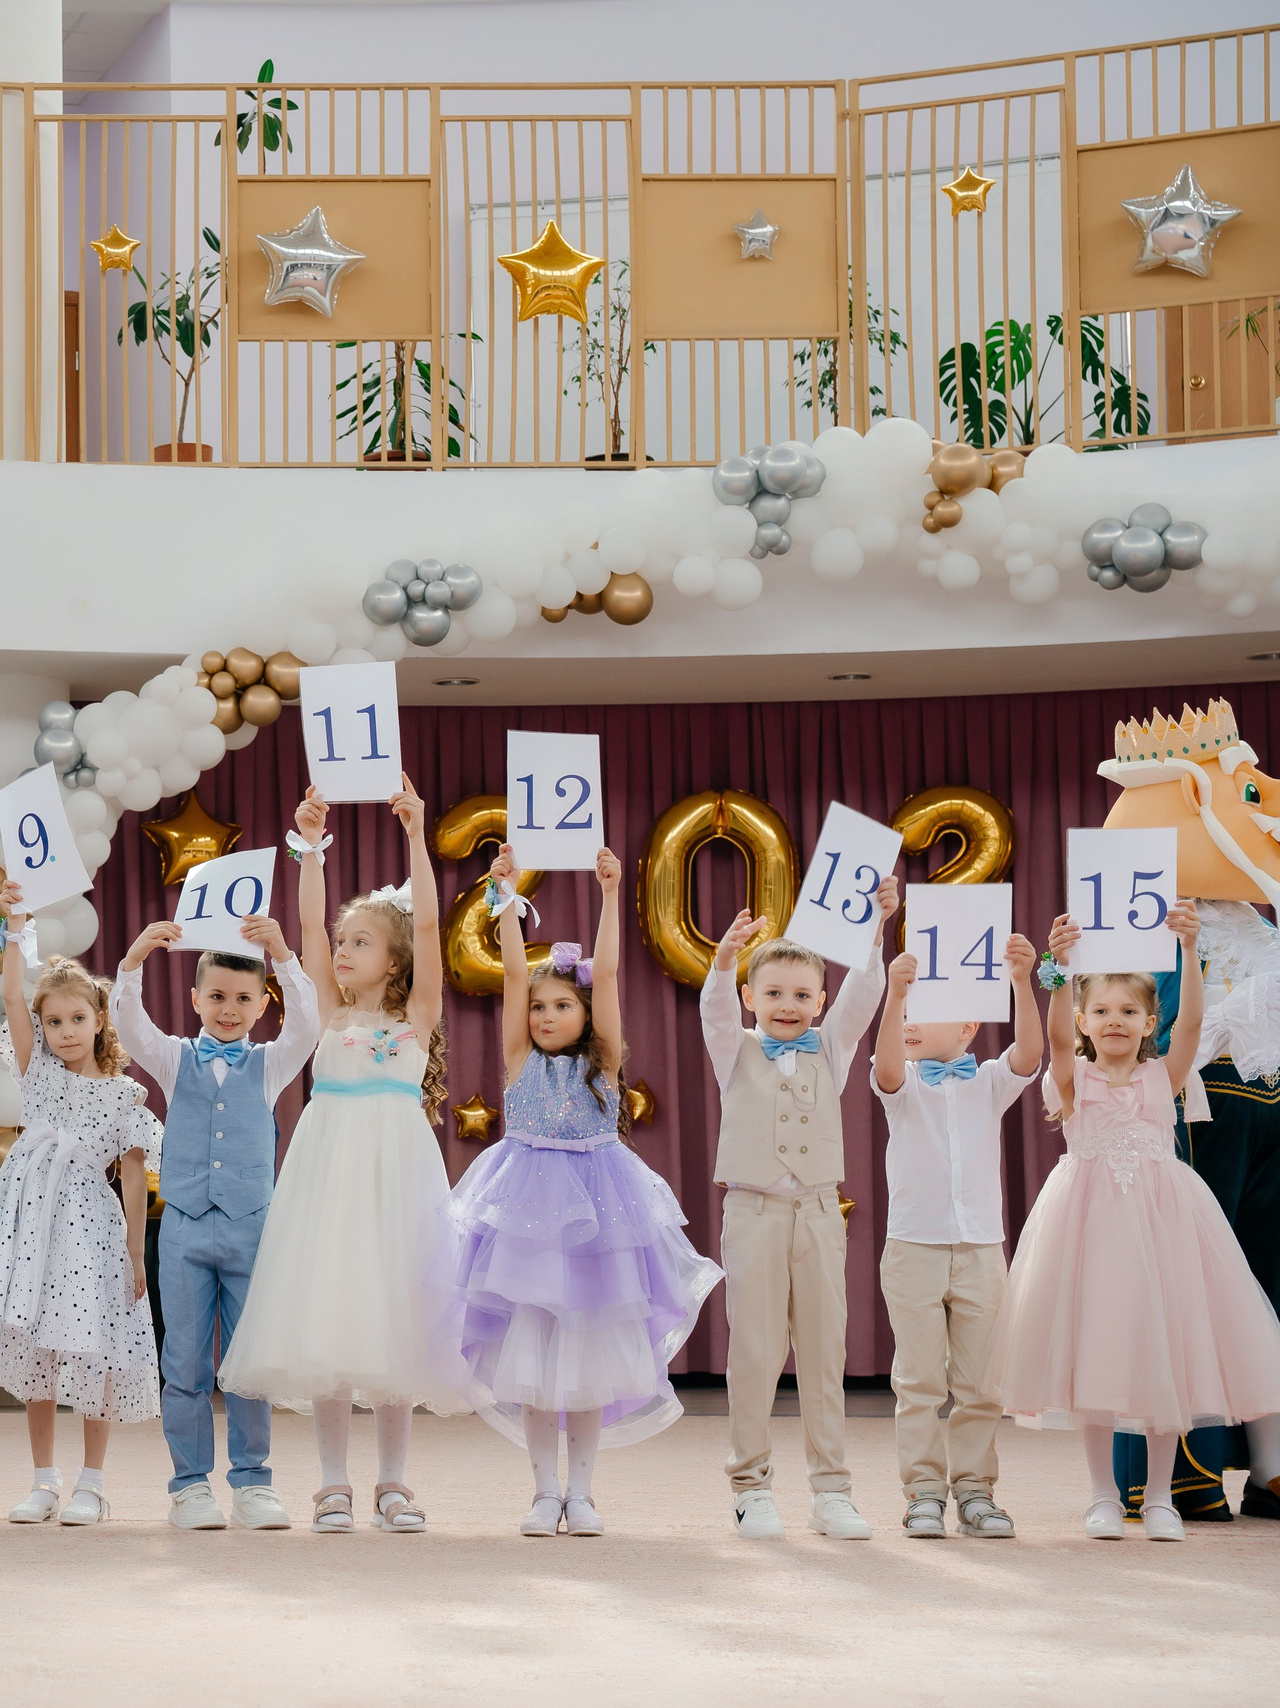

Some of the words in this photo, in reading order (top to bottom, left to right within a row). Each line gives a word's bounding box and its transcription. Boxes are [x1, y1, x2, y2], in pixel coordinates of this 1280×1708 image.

[312, 703, 391, 762] 11
[515, 773, 593, 831] 12
[185, 875, 264, 921] 10
[809, 851, 880, 925] 13
[1079, 870, 1168, 931] 15
[919, 925, 1002, 981] 14
